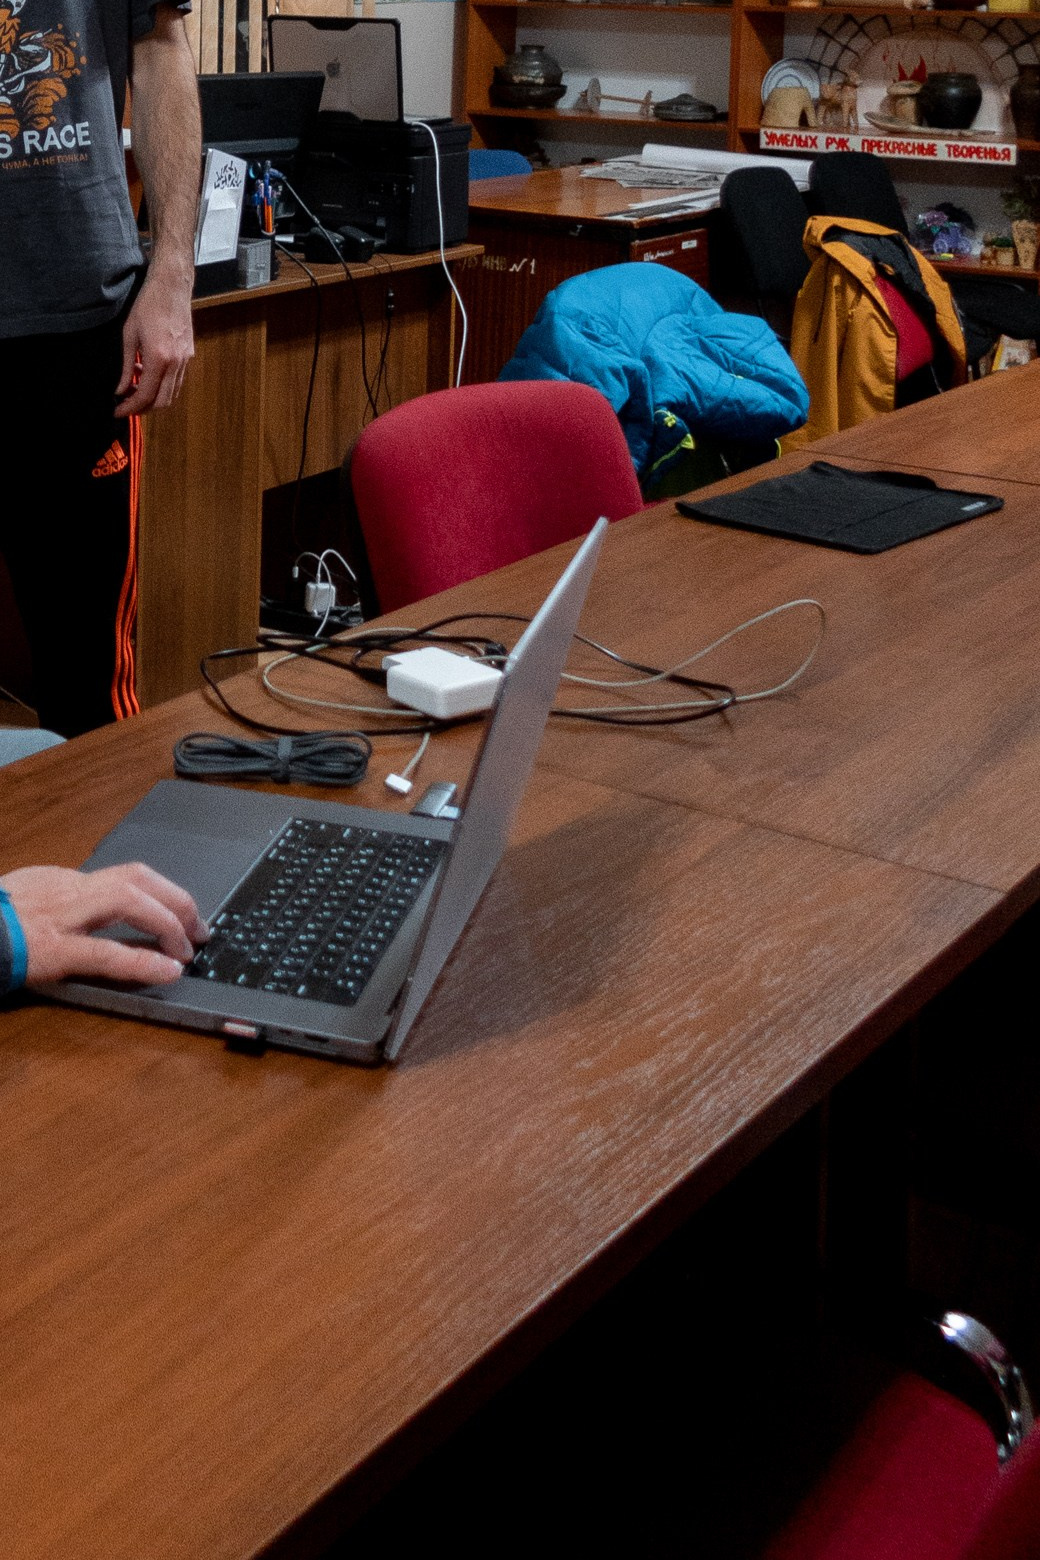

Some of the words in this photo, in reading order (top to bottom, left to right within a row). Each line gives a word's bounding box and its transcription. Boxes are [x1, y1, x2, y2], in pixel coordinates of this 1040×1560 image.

[22, 121, 92, 155] RACE
[763, 130, 819, 150] УМЕЛЫХ
[861, 138, 938, 158] ПРЕКРАСНЫЕ
[945, 143, 1012, 163] ТВОРЕНЬЯ
[91, 455, 129, 478] adidas
